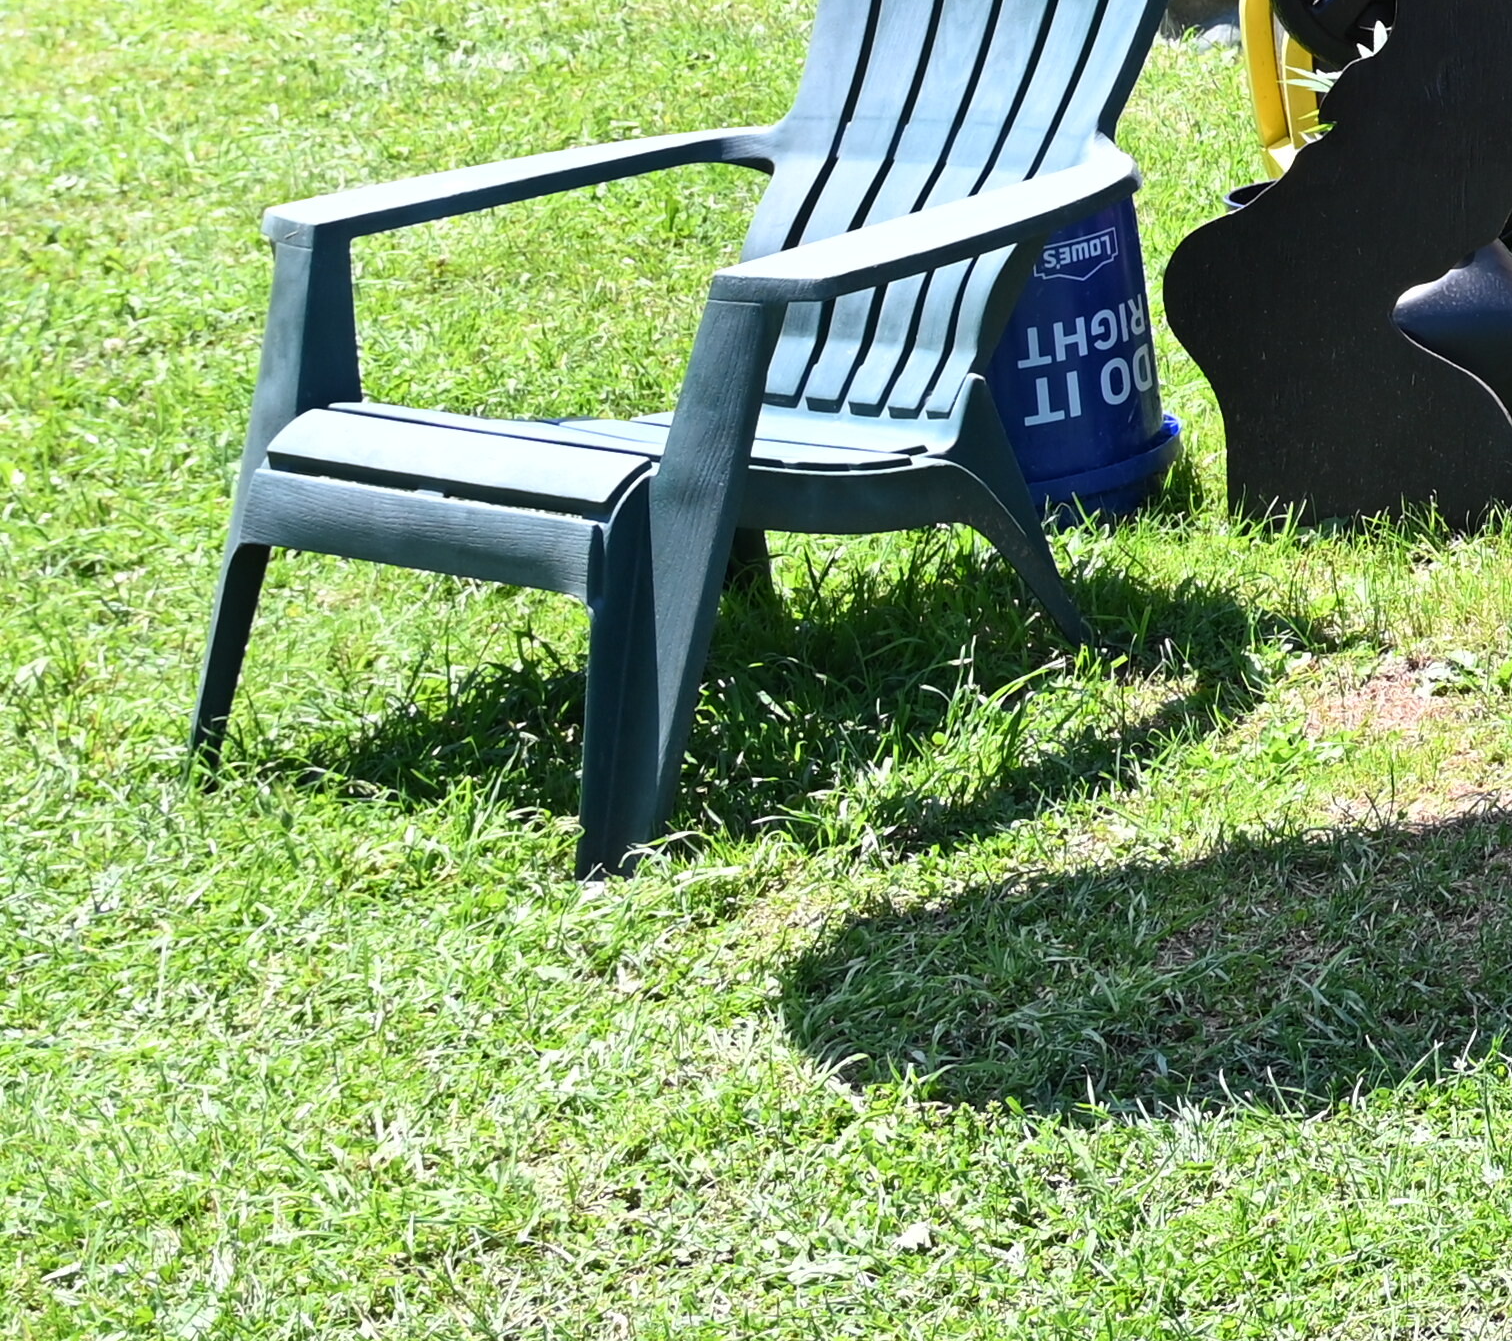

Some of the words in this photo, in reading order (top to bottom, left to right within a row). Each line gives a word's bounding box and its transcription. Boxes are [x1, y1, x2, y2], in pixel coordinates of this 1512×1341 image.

[1043, 234, 1112, 269] LOWE'S
[1017, 293, 1147, 369] RIGHT
[1024, 370, 1083, 427] IT
[1100, 343, 1155, 406] DO
